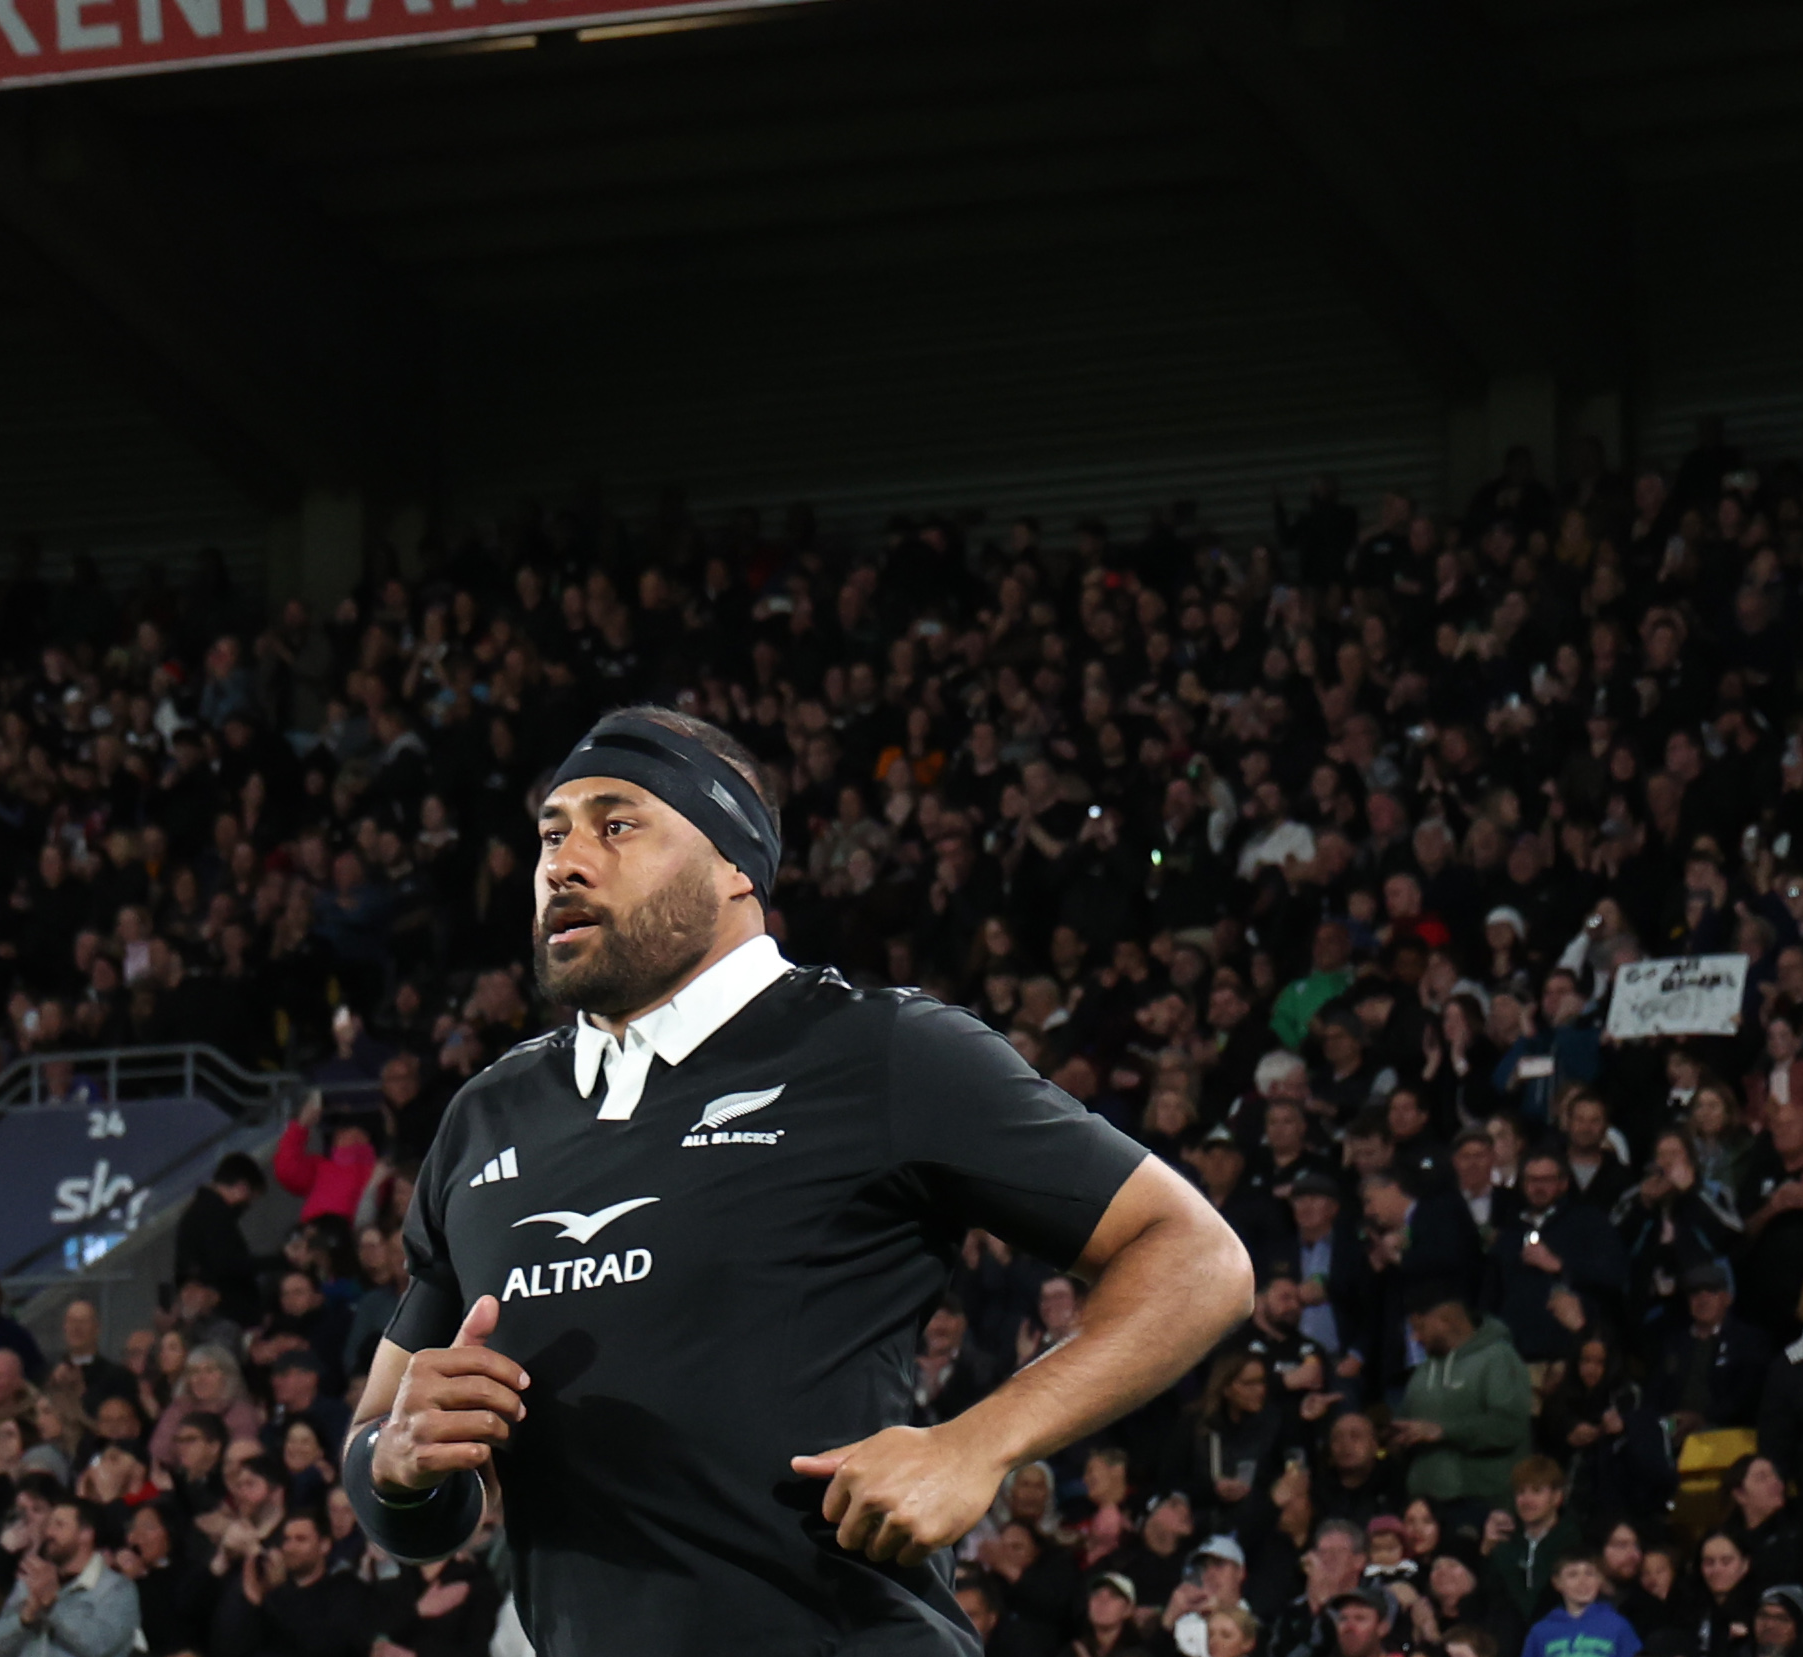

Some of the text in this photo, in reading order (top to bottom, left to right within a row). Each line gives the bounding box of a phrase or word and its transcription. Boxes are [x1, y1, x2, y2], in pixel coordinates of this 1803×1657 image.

[88, 1110, 126, 1139] 24
[682, 1131, 778, 1147] ALL BLACKS
[501, 1248, 653, 1302] ALTRAD
